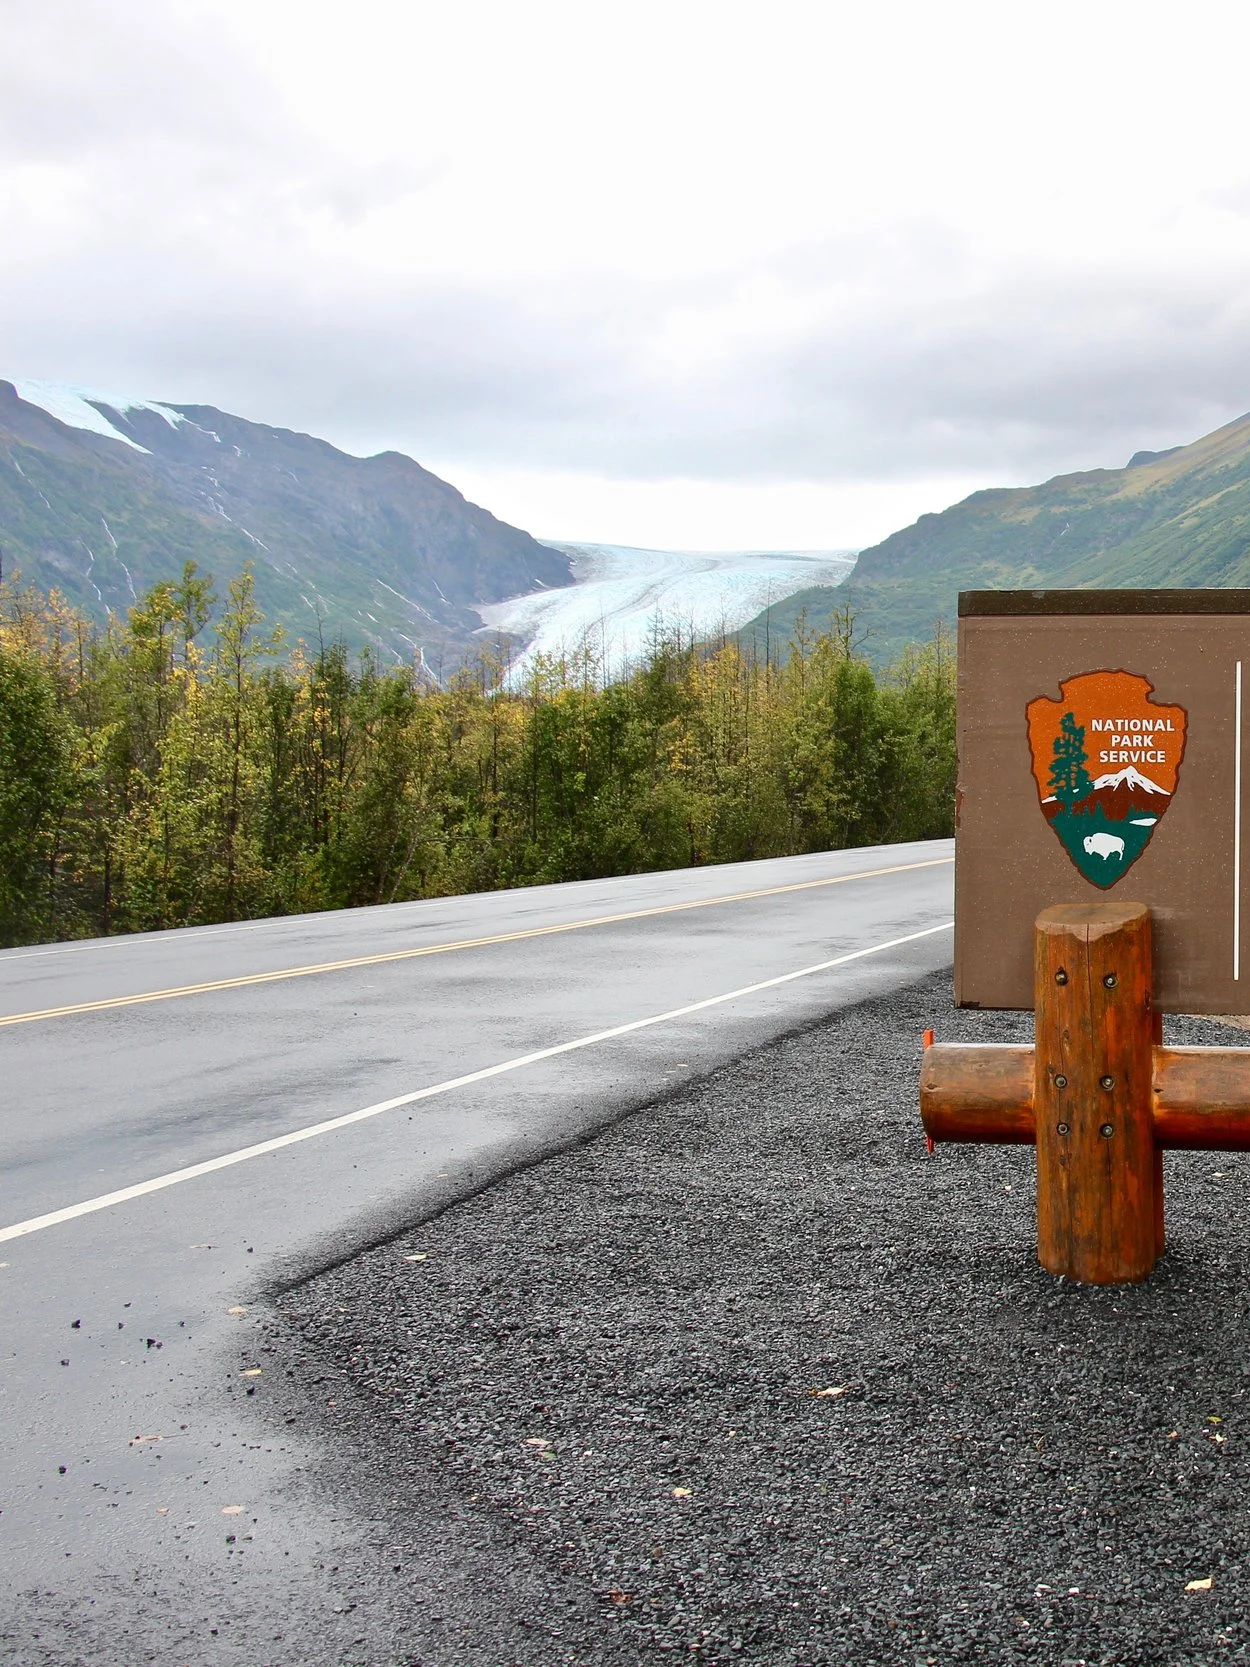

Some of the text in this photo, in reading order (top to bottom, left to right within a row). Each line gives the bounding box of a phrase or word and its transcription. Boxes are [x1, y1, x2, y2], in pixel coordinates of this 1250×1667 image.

[1091, 719, 1175, 732] NATIONAL
[1111, 735, 1154, 747] PARK
[1099, 750, 1166, 763] SERVICE
